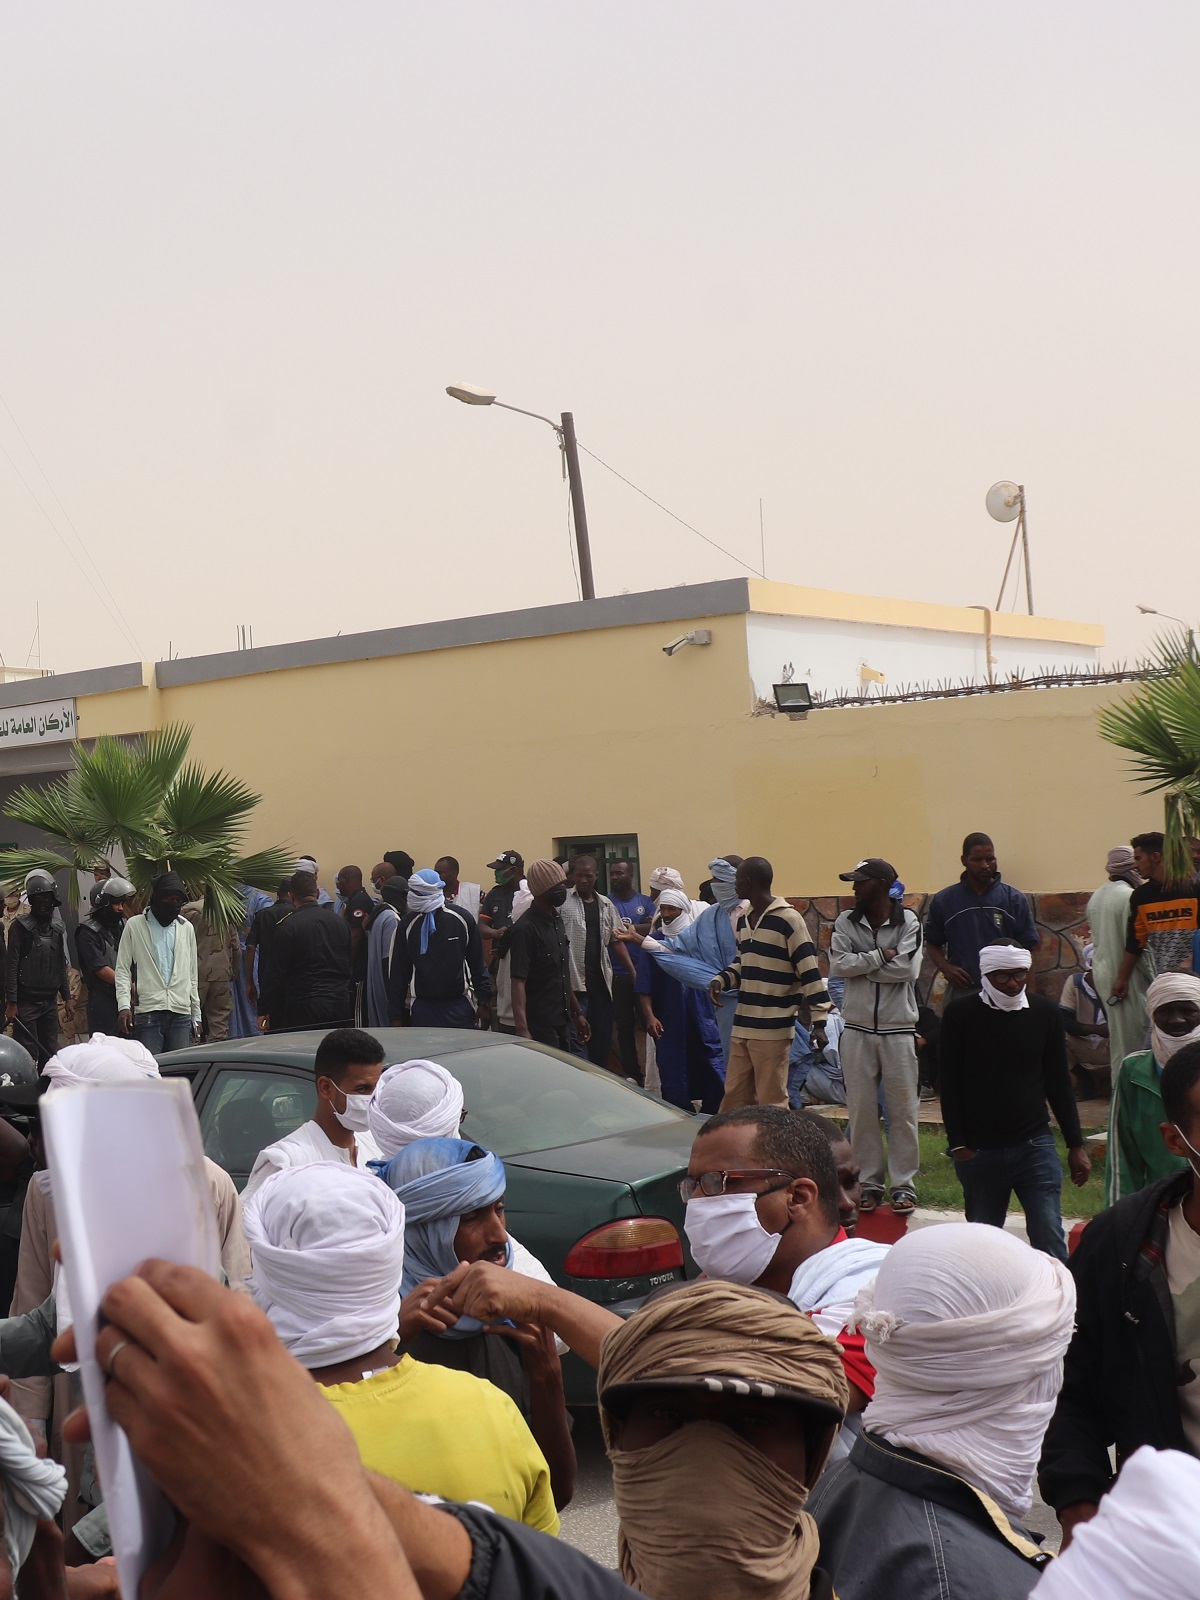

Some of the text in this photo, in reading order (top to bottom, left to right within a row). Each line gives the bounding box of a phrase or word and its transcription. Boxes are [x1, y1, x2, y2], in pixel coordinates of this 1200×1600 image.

[10, 714, 37, 735] العامة
[39, 706, 73, 737] الأركان
[1146, 908, 1193, 921] FAMOUS
[649, 1272, 674, 1286] TOYOTA
